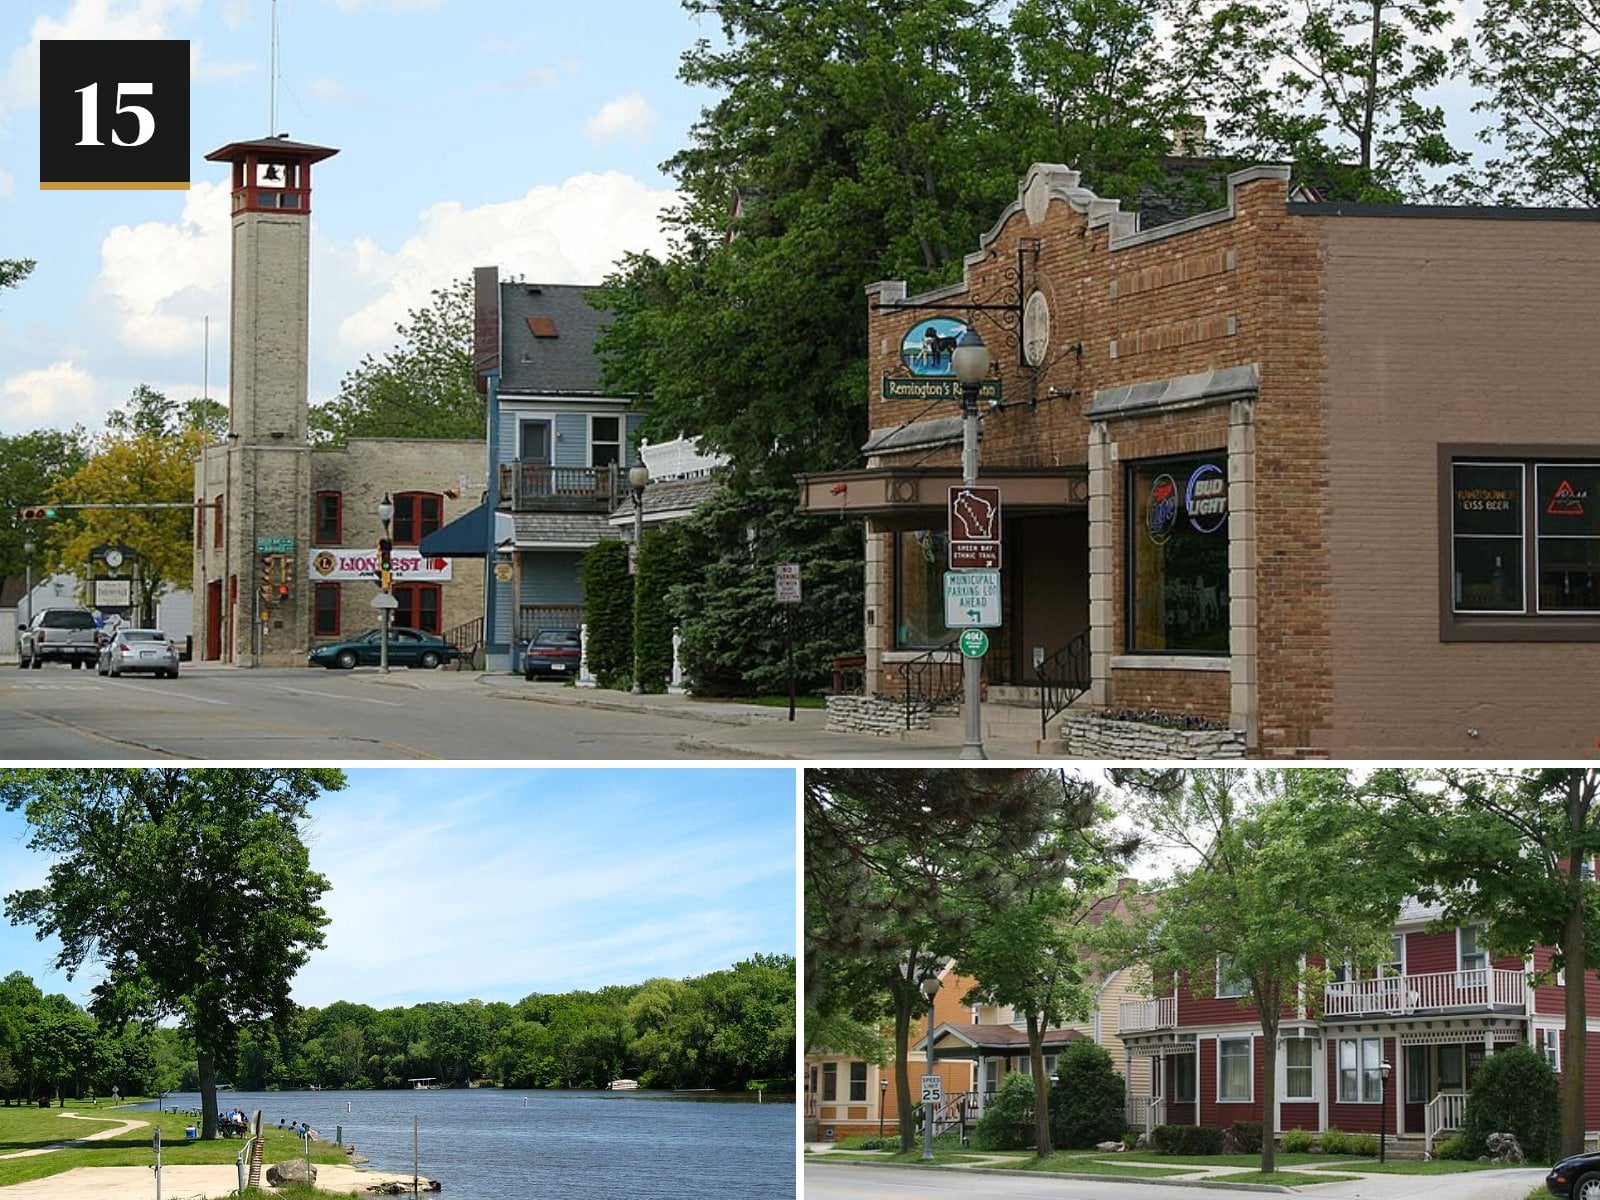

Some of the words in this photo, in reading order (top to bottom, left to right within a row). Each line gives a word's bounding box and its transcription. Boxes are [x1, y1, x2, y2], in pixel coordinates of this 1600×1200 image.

[889, 381, 950, 398] Remington's
[1195, 478, 1223, 496] BUD
[1188, 497, 1228, 516] LIGHT
[1486, 501, 1509, 510] BEER
[322, 559, 329, 568] L
[339, 556, 422, 572] LIONEST
[949, 574, 995, 586] MUNICIPAL
[947, 586, 980, 597] PARKING
[982, 586, 998, 597] LOT
[959, 596, 987, 607] AHEAD
[922, 1089, 940, 1100] 25
